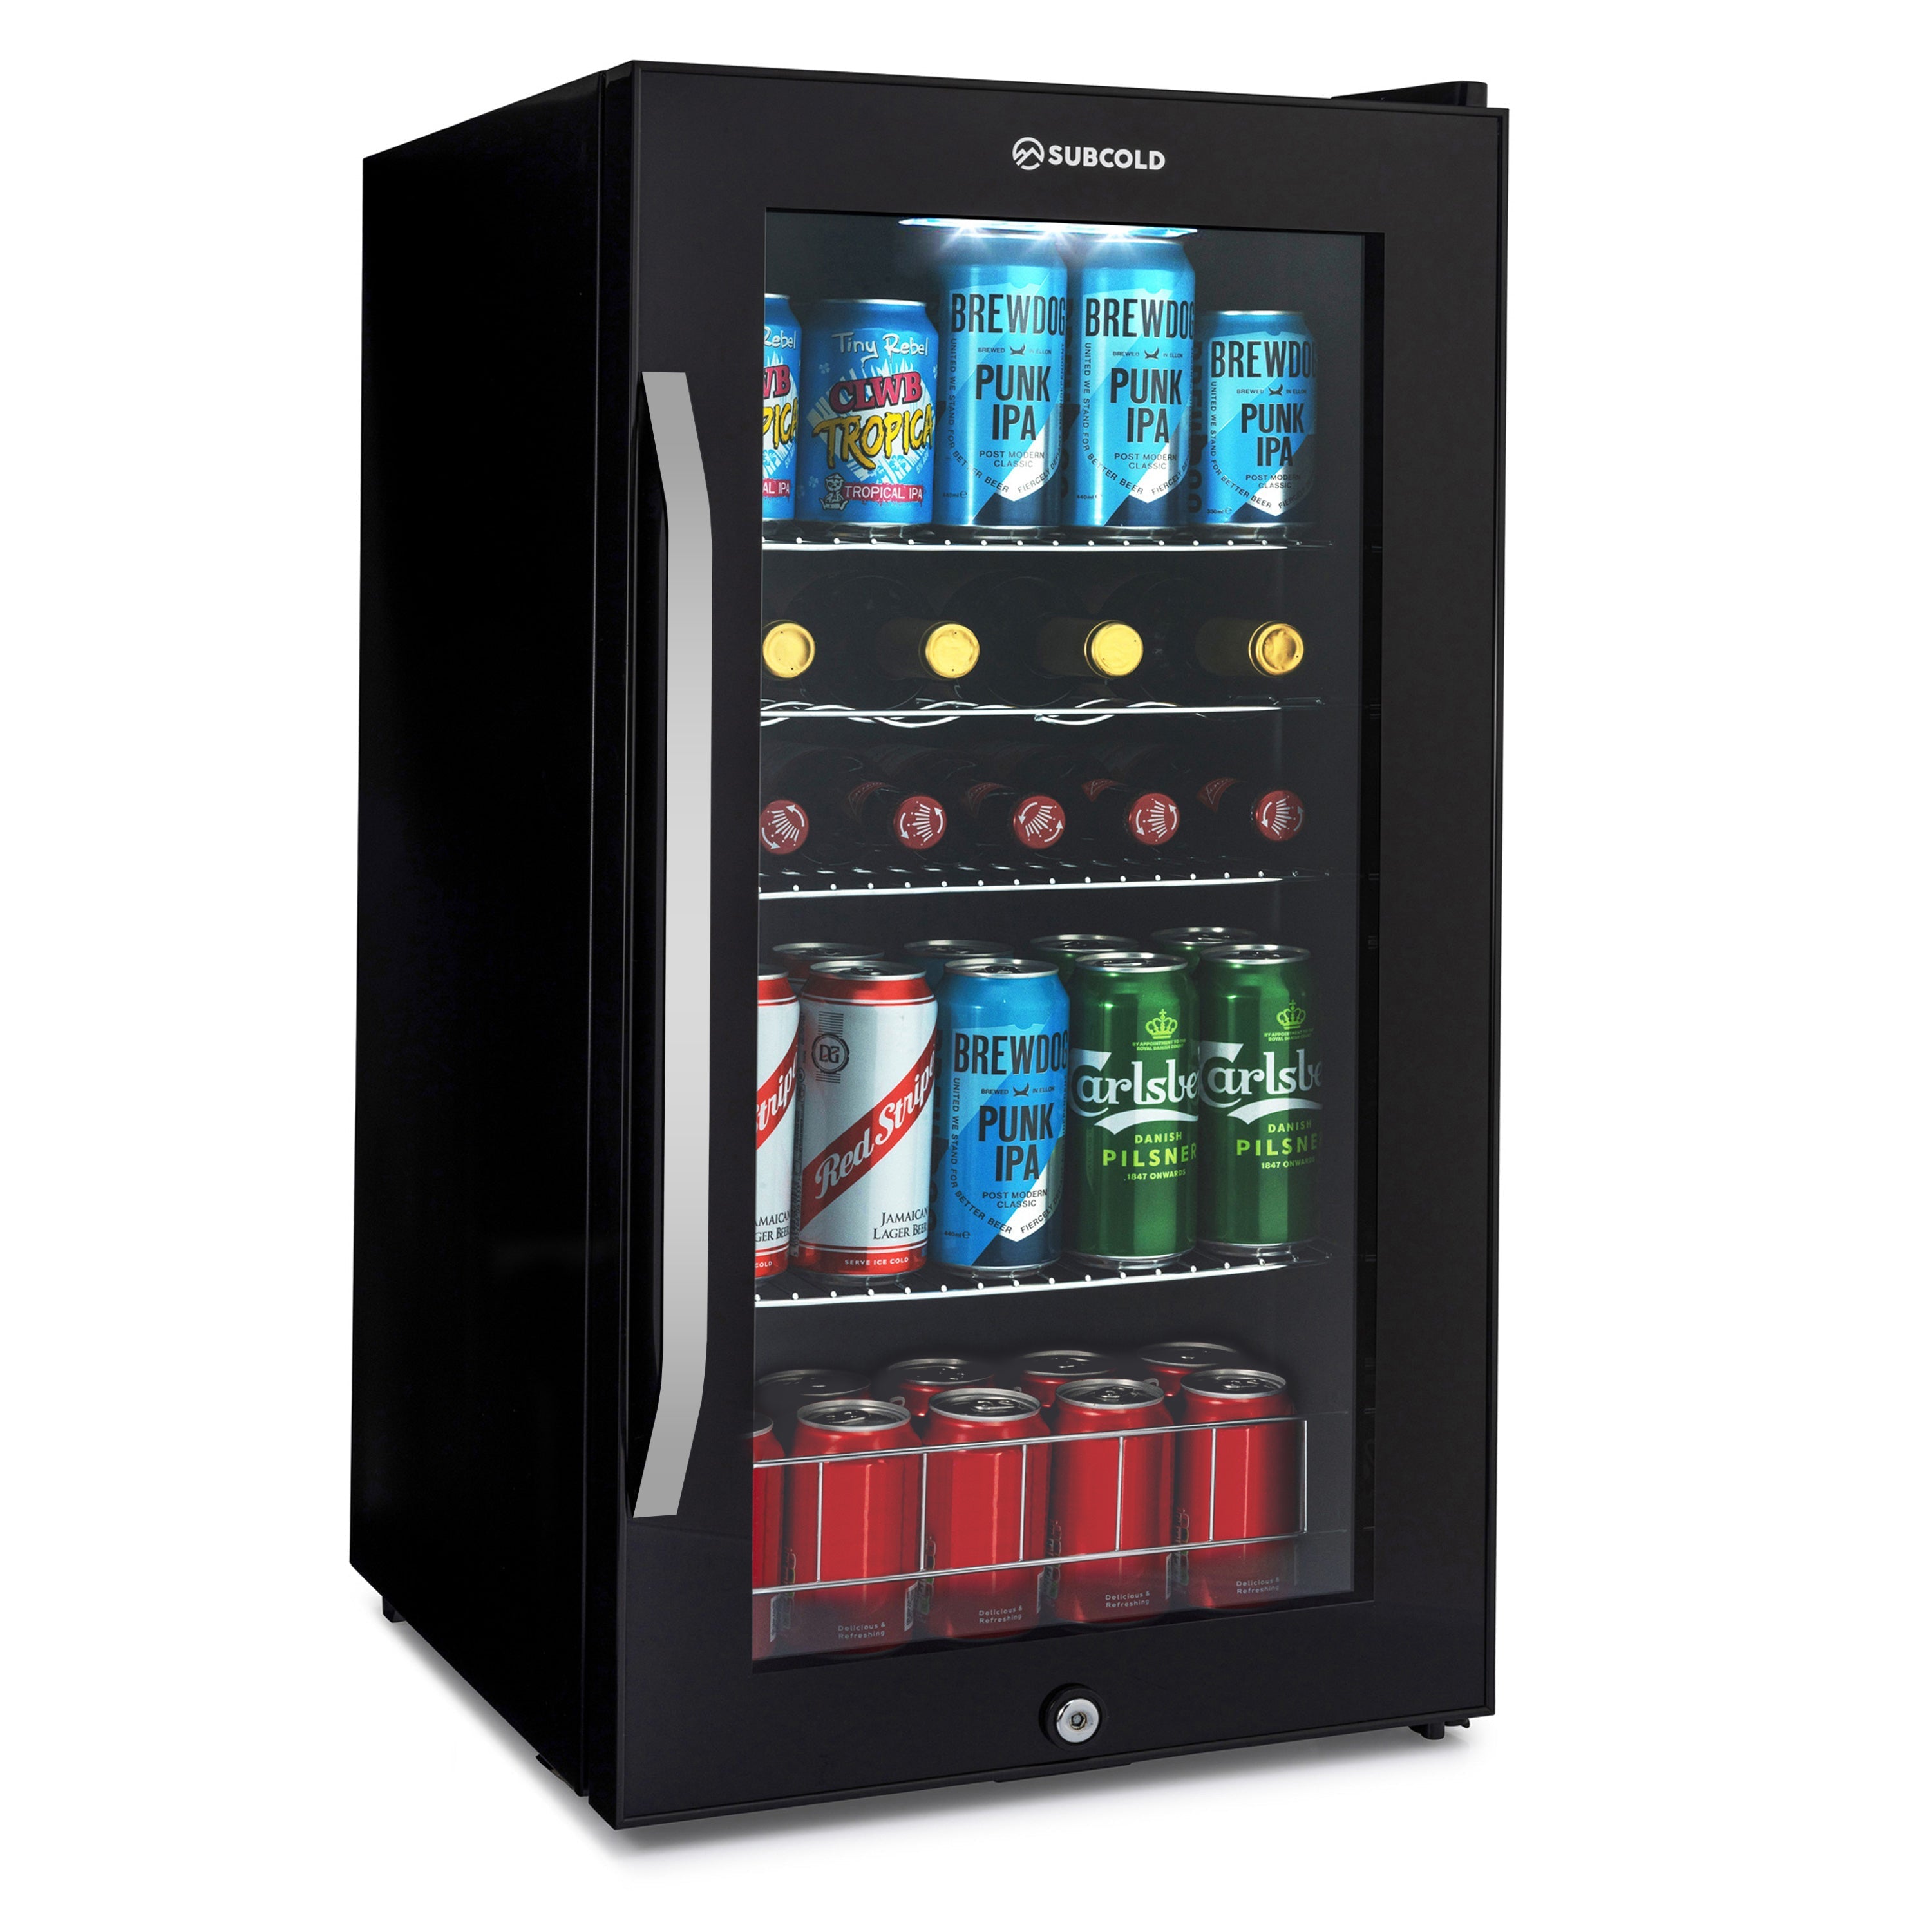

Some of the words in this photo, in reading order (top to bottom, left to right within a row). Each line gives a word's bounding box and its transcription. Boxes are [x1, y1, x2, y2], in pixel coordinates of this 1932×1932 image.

[1048, 144, 1166, 170] SUBCOLD
[951, 293, 1066, 336] BREWDOG
[831, 332, 879, 366] Tiny
[882, 333, 929, 359] Rebel
[829, 371, 922, 413] CLWB
[949, 376, 956, 391] WE
[976, 364, 1051, 402] PUNK
[1110, 368, 1182, 405] PUNK
[992, 404, 1036, 441] IPA
[1127, 407, 1170, 444] IPA
[1210, 414, 1217, 426] WE
[1241, 402, 1305, 433] PUNK
[1083, 380, 1091, 393] WE
[1087, 453, 1117, 480] BETTER
[1119, 478, 1143, 494] BEER
[1257, 436, 1293, 467] IPA
[952, 451, 983, 478] BETTER
[1211, 459, 1222, 476] FOR
[778, 484, 790, 494] IPA
[844, 486, 905, 499] TROPICAL
[909, 488, 922, 499] IPA
[984, 477, 1009, 493] BEER
[1018, 470, 1050, 494] FIERCELY
[1151, 471, 1181, 495] FIERCELY
[1221, 475, 1250, 498] BETTER
[1250, 495, 1273, 508] BEER
[954, 1030, 1068, 1075] BREWDOG
[1068, 1048, 1199, 1117] Carlsbe
[952, 1078, 960, 1112] UNITED
[951, 1116, 959, 1130] WE
[978, 1103, 1054, 1142] PUNK
[1268, 1120, 1312, 1133] DANISH
[951, 1134, 959, 1165] STAND
[1134, 1132, 1182, 1144] DANISH
[1236, 1132, 1321, 1156] PILSNE
[815, 1127, 874, 1199] Red
[995, 1144, 1041, 1182] IPA
[1103, 1142, 1197, 1167] PILSNER
[1150, 1169, 1186, 1180] ONWARDS
[955, 1190, 986, 1220] BETTER
[996, 1200, 1036, 1208] CLASSIC
[1011, 1189, 1048, 1198] MODERN
[880, 1206, 928, 1227] JAMAICAN
[987, 1217, 1012, 1234] BEER
[1020, 1205, 1053, 1233] FIERCELY
[873, 1227, 910, 1240] LAGER
[913, 1222, 927, 1236] BEER
[1236, 1586, 1279, 1594] Refreshing
[1106, 1599, 1150, 1608] Refreshing
[979, 1614, 1022, 1624] Refreshing
[838, 1631, 885, 1639] Refreshing
